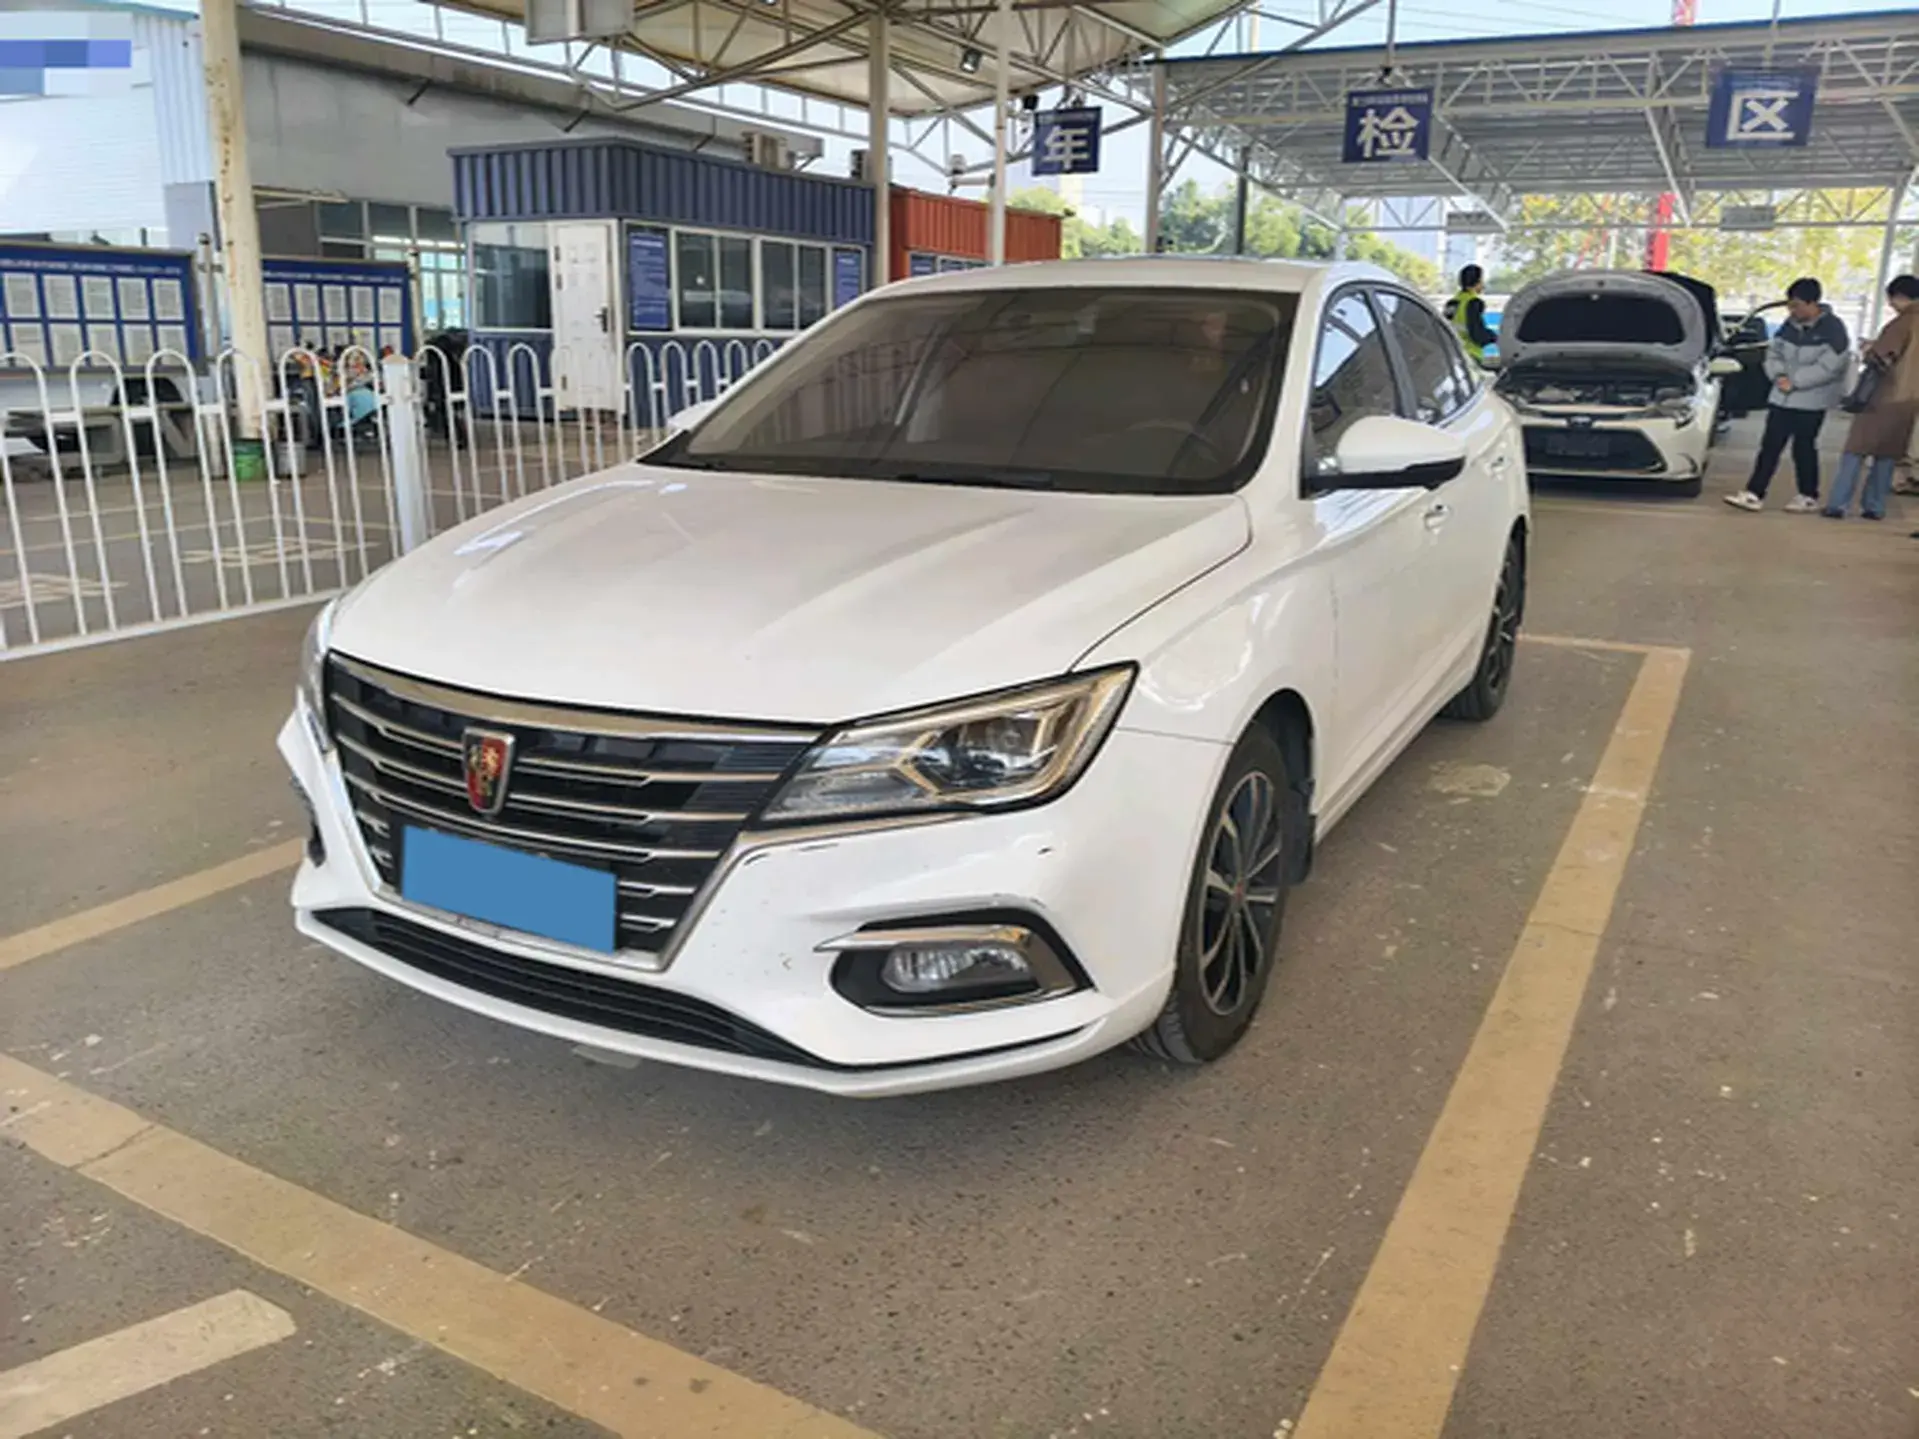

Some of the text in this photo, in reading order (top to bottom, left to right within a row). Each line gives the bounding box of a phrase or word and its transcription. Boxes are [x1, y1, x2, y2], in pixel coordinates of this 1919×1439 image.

[1356, 107, 1420, 158] 检
[1727, 90, 1799, 140] 区
[1041, 125, 1089, 170] 年
